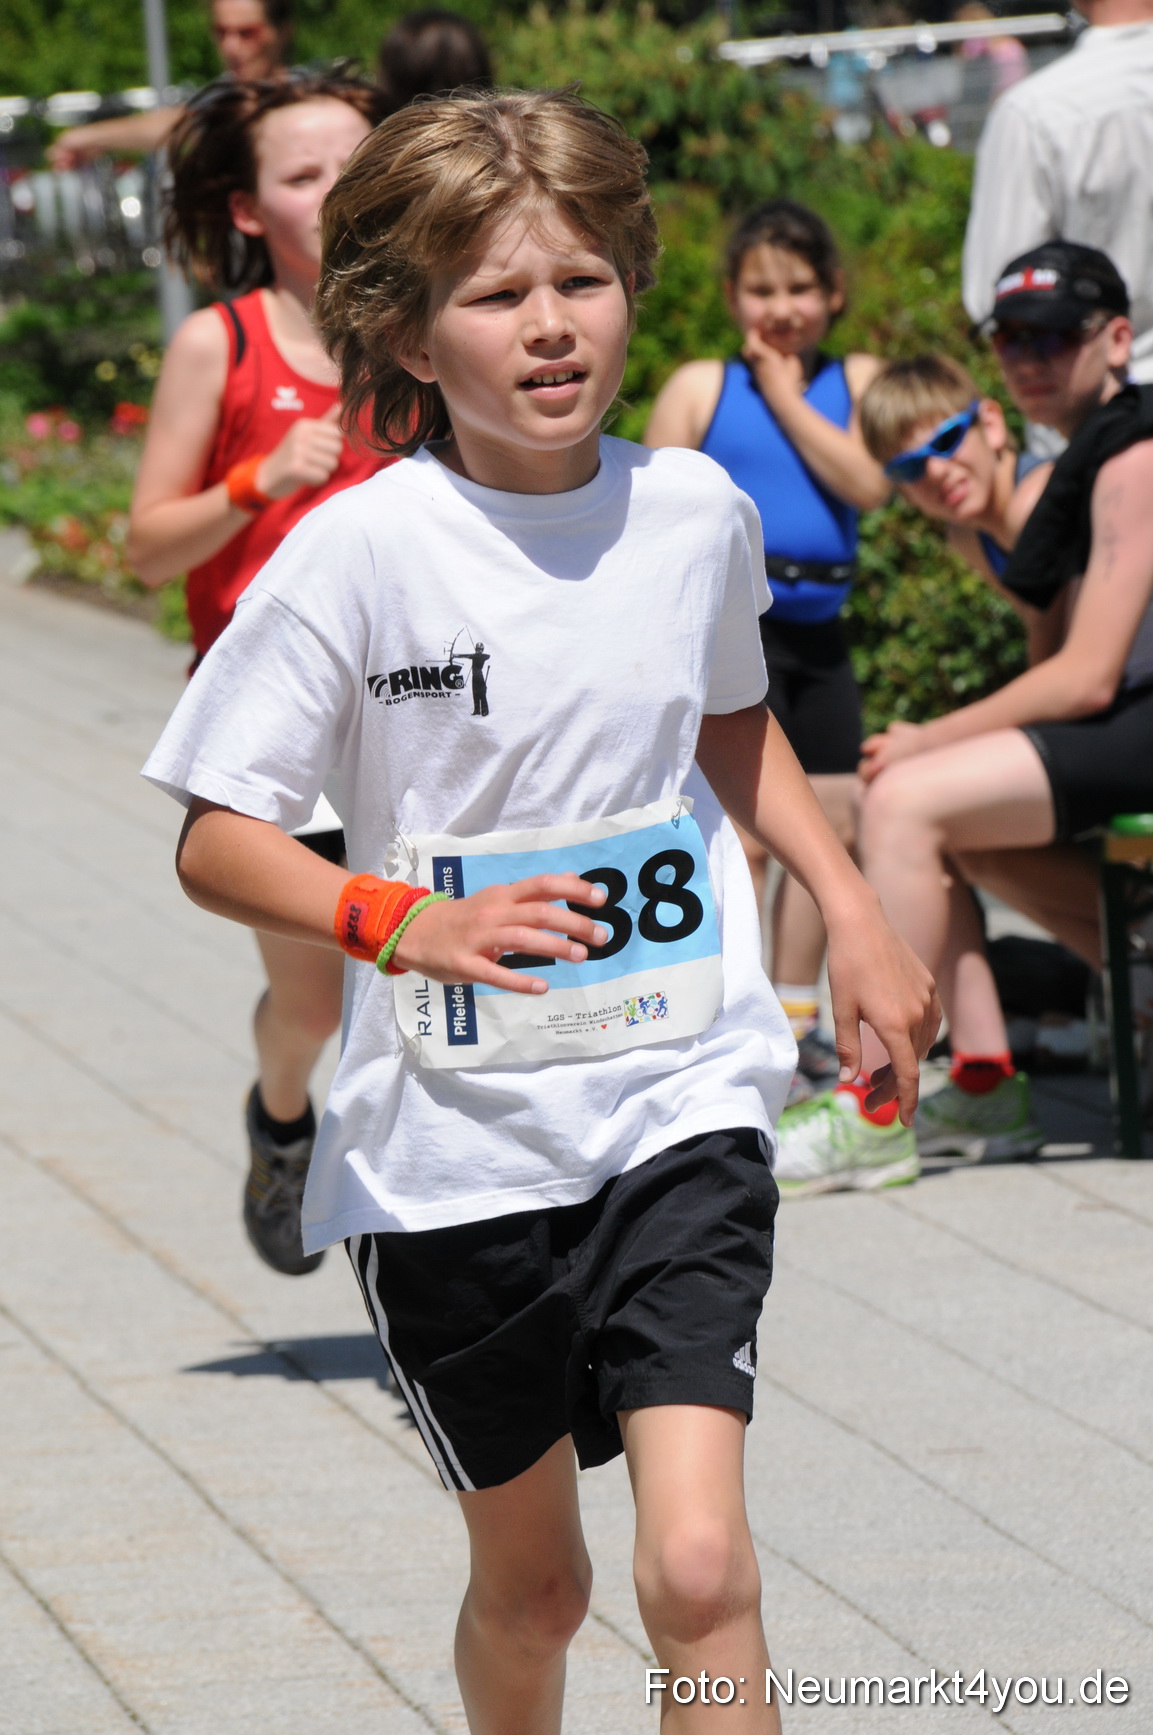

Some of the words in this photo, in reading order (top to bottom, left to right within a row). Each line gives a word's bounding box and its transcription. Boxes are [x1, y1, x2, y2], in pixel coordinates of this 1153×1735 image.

[496, 848, 704, 970] 88
[414, 979, 433, 1036] RAIL
[547, 1013, 565, 1022] LGS
[575, 1004, 622, 1020] Triathlon
